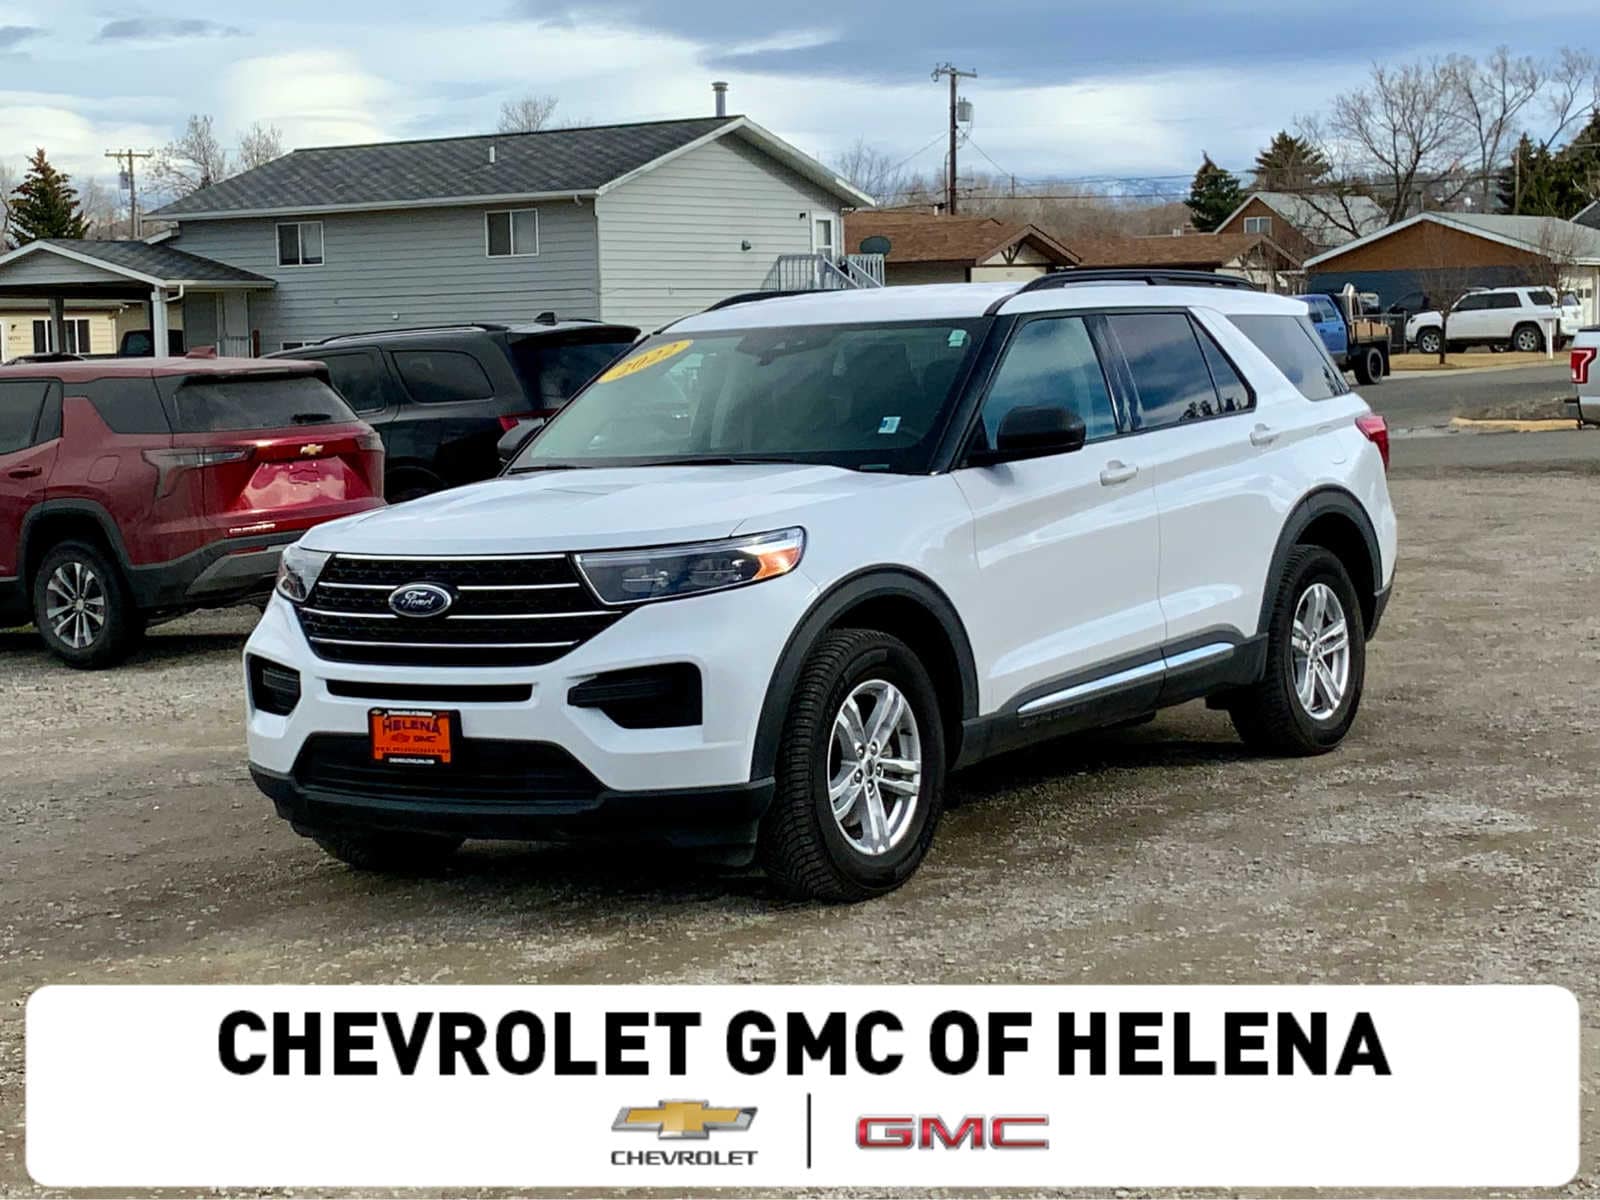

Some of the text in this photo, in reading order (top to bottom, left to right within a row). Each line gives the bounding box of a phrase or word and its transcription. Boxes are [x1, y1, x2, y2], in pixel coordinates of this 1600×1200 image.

[617, 343, 679, 376] 2022
[400, 590, 435, 608] Ford
[382, 718, 441, 736] HELENA
